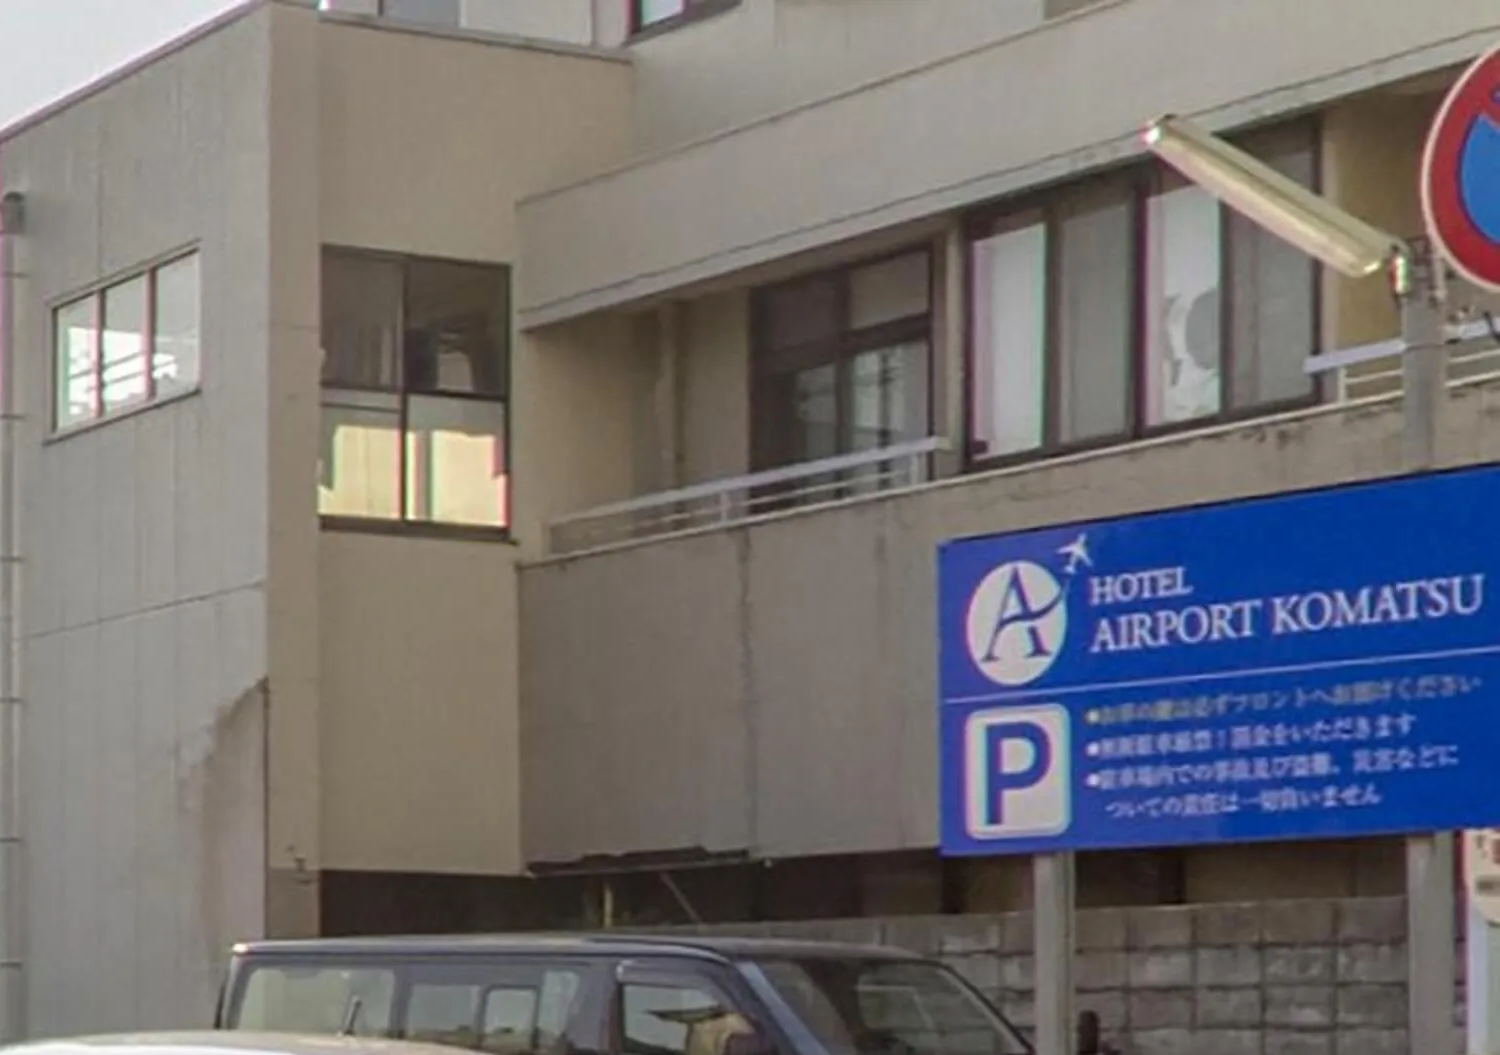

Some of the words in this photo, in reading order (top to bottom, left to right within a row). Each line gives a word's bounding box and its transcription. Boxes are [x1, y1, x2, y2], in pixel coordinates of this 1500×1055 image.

[1089, 566, 1194, 605] HOTEL
[1090, 599, 1263, 653] AIRPORT
[1272, 573, 1486, 636] KOMATSU
[985, 721, 1052, 825] P
